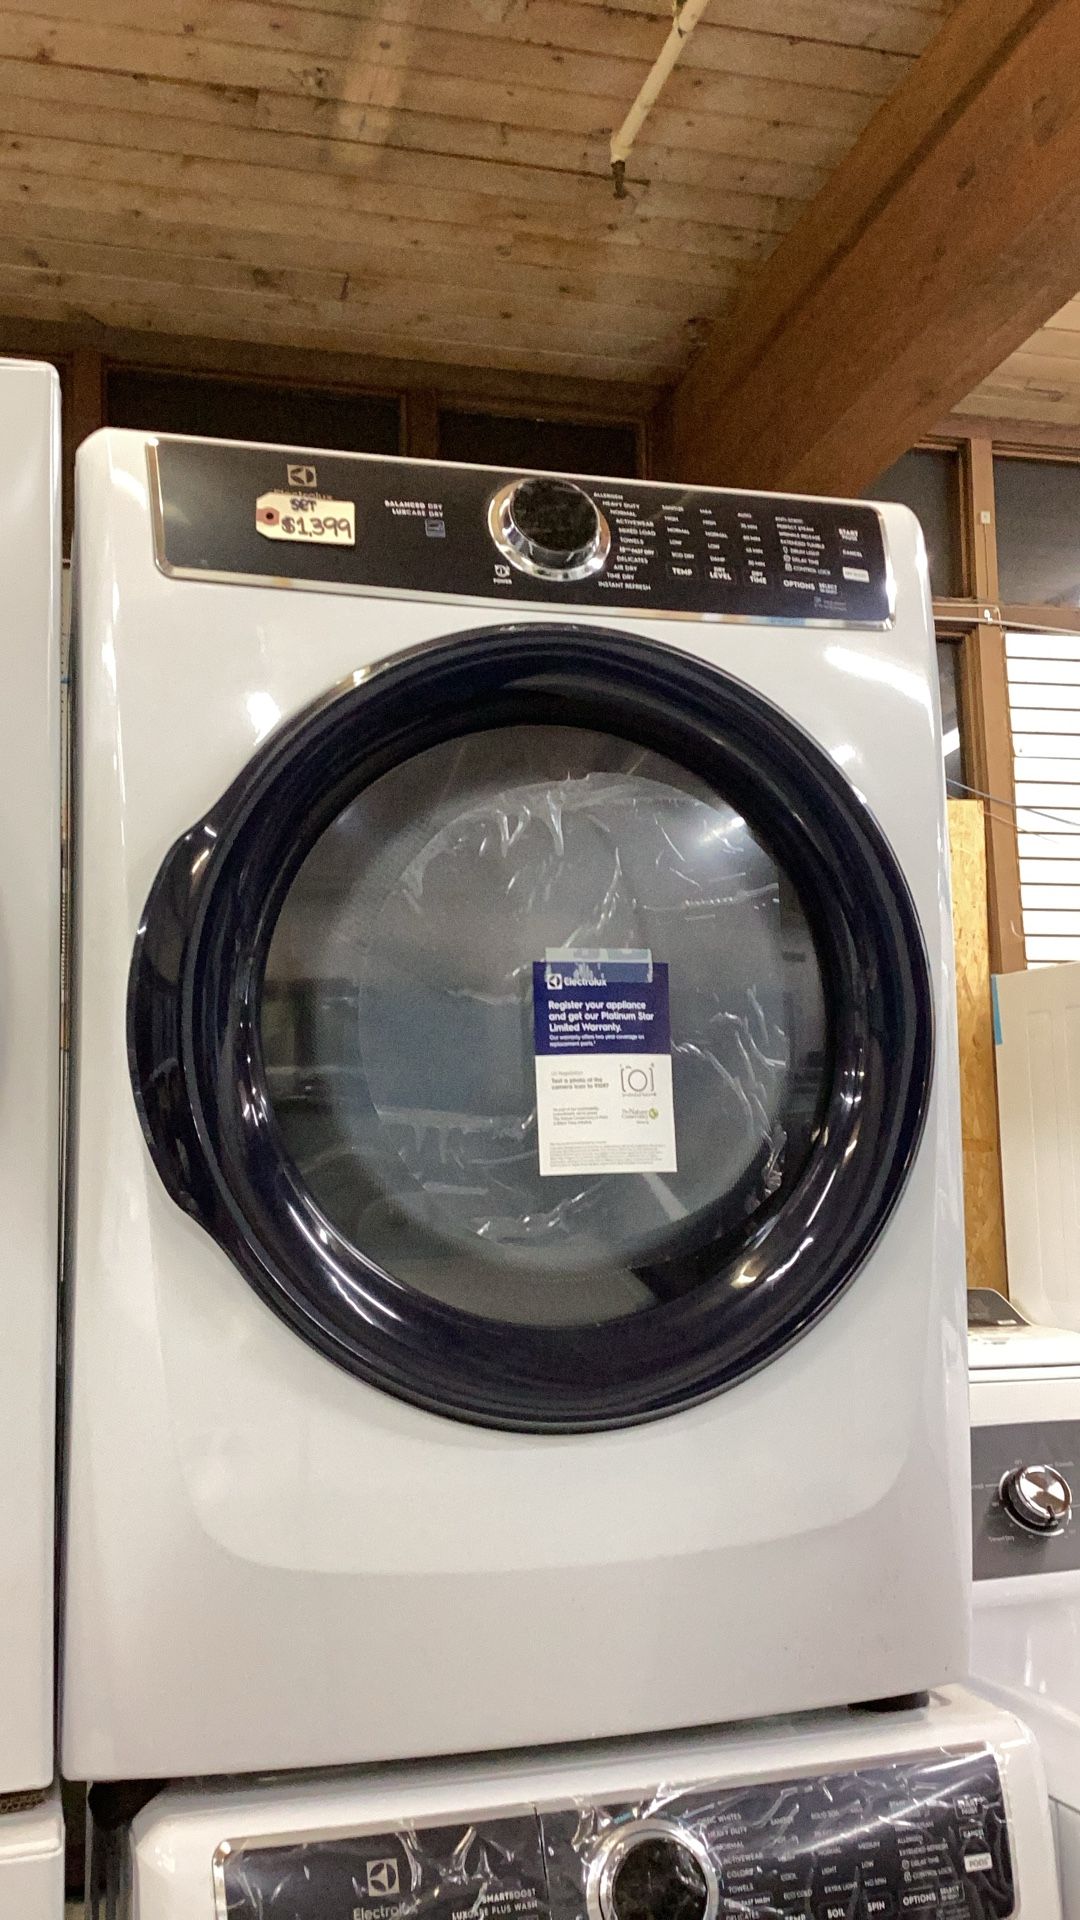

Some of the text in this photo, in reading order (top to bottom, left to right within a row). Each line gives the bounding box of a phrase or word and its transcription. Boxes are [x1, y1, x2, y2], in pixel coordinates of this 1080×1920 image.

[289, 499, 317, 512] SET
[384, 500, 443, 510] BALANCED DRY
[428, 510, 443, 518] DRY
[609, 509, 637, 518] NORMAL
[281, 515, 352, 538] $1,399
[615, 518, 654, 527] ACTIVEWEAR
[620, 536, 644, 545] TOWELS
[616, 555, 648, 564] DELICATES
[606, 572, 621, 580] TIME
[671, 566, 693, 576] TEMP
[709, 571, 732, 580] LEVEL
[597, 581, 624, 589] INSTANT
[749, 575, 767, 585] TIME
[783, 579, 816, 591] OPTIONS
[563, 976, 607, 987] Electrolux
[548, 1000, 647, 1011] Register your appliance
[548, 1012, 566, 1021] and
[567, 1013, 582, 1022] get
[600, 1012, 637, 1021] Platinum
[637, 1013, 655, 1021] Star
[549, 1023, 622, 1033] Limited Warranty.
[728, 1882, 754, 1894] TOWELS
[481, 1887, 536, 1904] SMARTBOOST
[902, 1892, 937, 1906] OPTIONS
[491, 1904, 512, 1915] PLUS
[514, 1899, 538, 1912] WASH
[867, 1900, 885, 1913] SPIN
